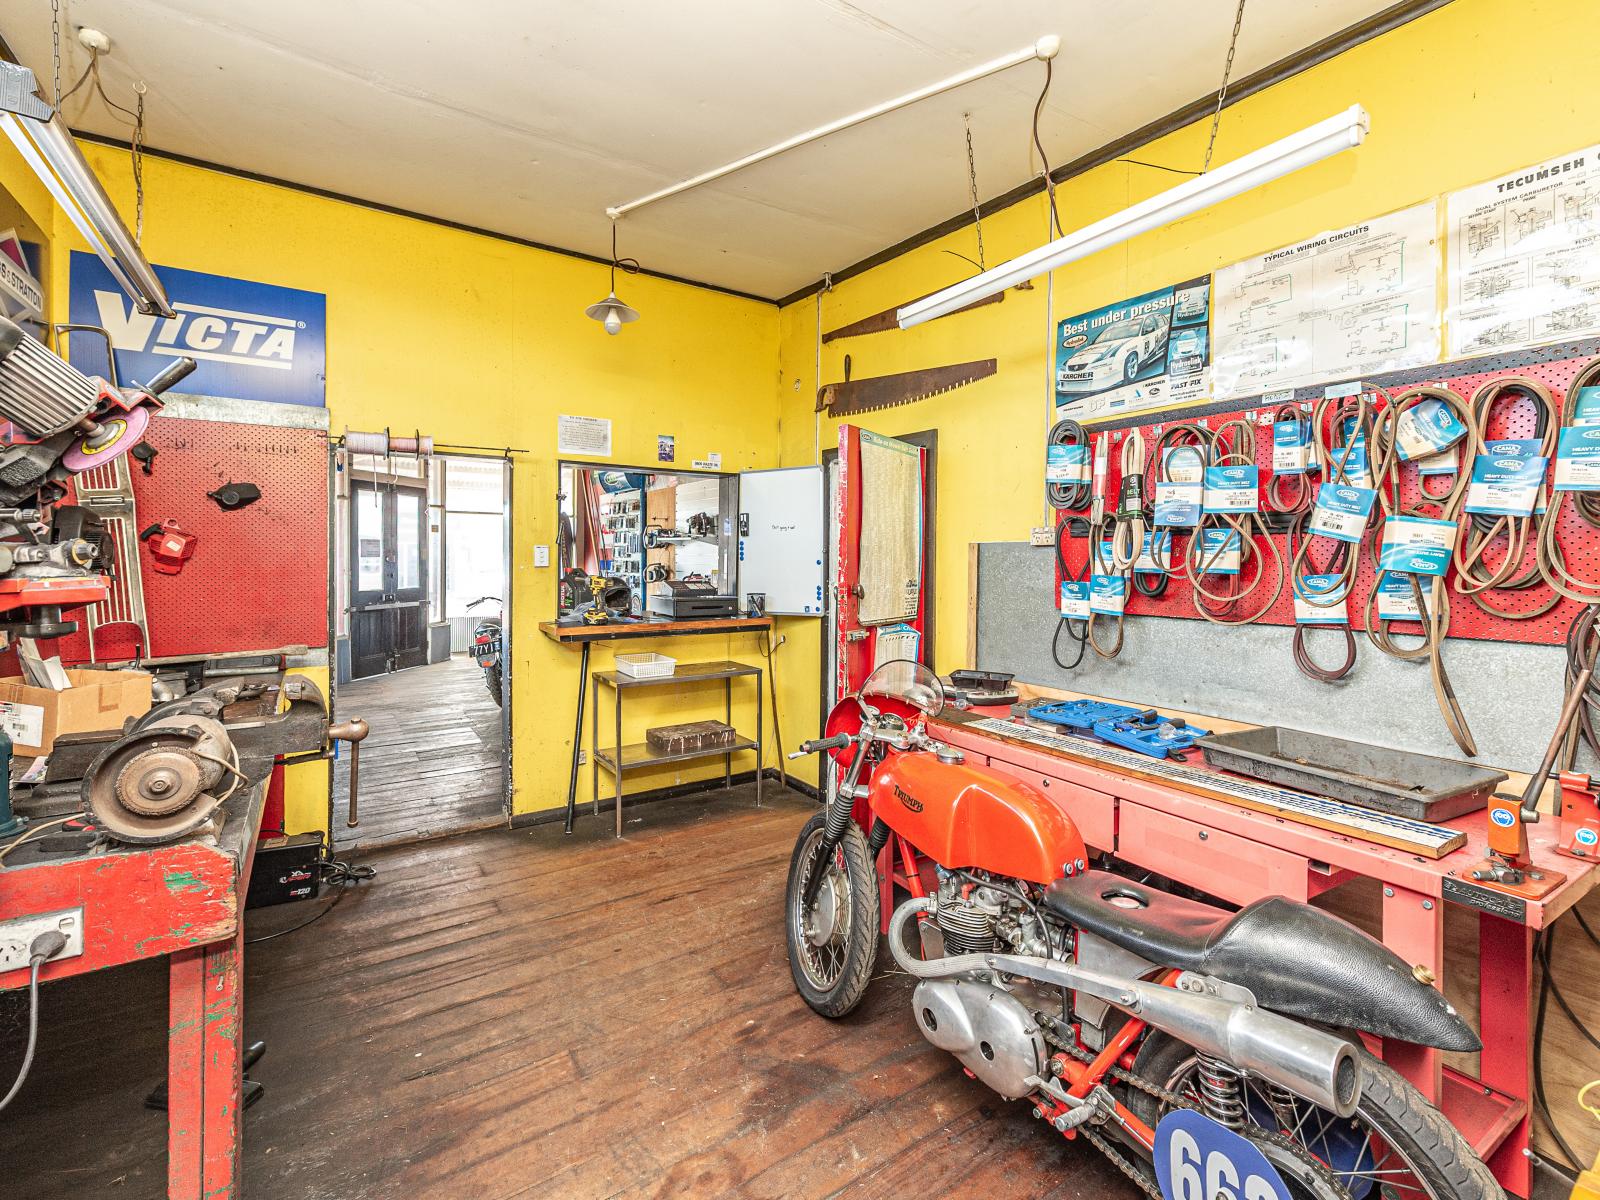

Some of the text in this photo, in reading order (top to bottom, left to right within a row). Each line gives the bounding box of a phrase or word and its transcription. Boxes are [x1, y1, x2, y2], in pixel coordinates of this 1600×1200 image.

[1497, 157, 1585, 193] TECUMSEH
[1475, 181, 1564, 213] DUAL SYSTEM CARBURETOR
[1263, 249, 1295, 264] TYPICAL
[1296, 239, 1327, 253] WIRING
[1329, 225, 1369, 243] CIRCUITS
[11, 272, 42, 311] STRATTON
[94, 289, 296, 361] VICTA
[1063, 290, 1191, 337] Best under pressure
[1171, 379, 1202, 390] FAST FIX
[894, 784, 924, 812] TRIUMPH
[1470, 899, 1522, 919] professional
